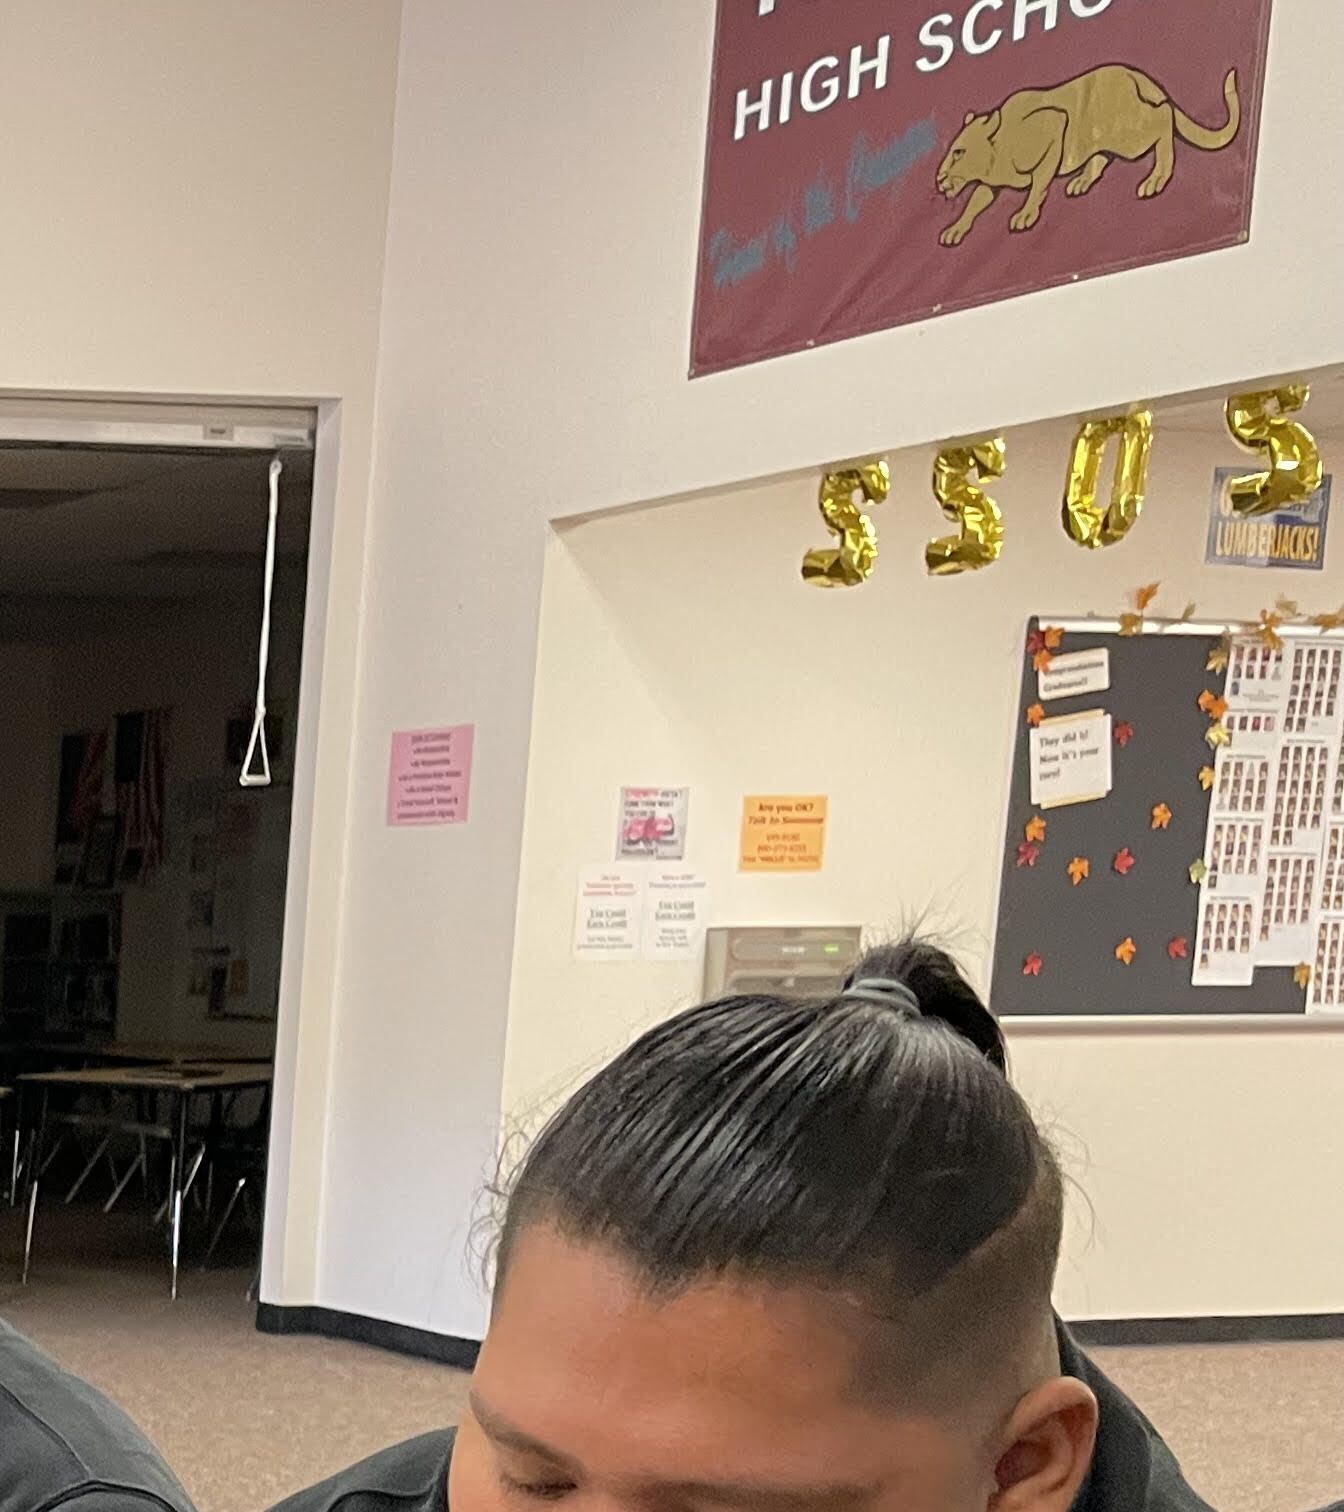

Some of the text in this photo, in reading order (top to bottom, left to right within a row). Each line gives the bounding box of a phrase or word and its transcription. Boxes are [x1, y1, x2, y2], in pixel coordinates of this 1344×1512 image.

[733, 34, 891, 141] HIGH
[1215, 521, 1320, 562] LUMBERJACKS!
[1040, 737, 1060, 747] They
[1062, 732, 1077, 743] did
[1040, 747, 1099, 765] Now it's your
[775, 804, 793, 815] you
[795, 802, 814, 812] OK?
